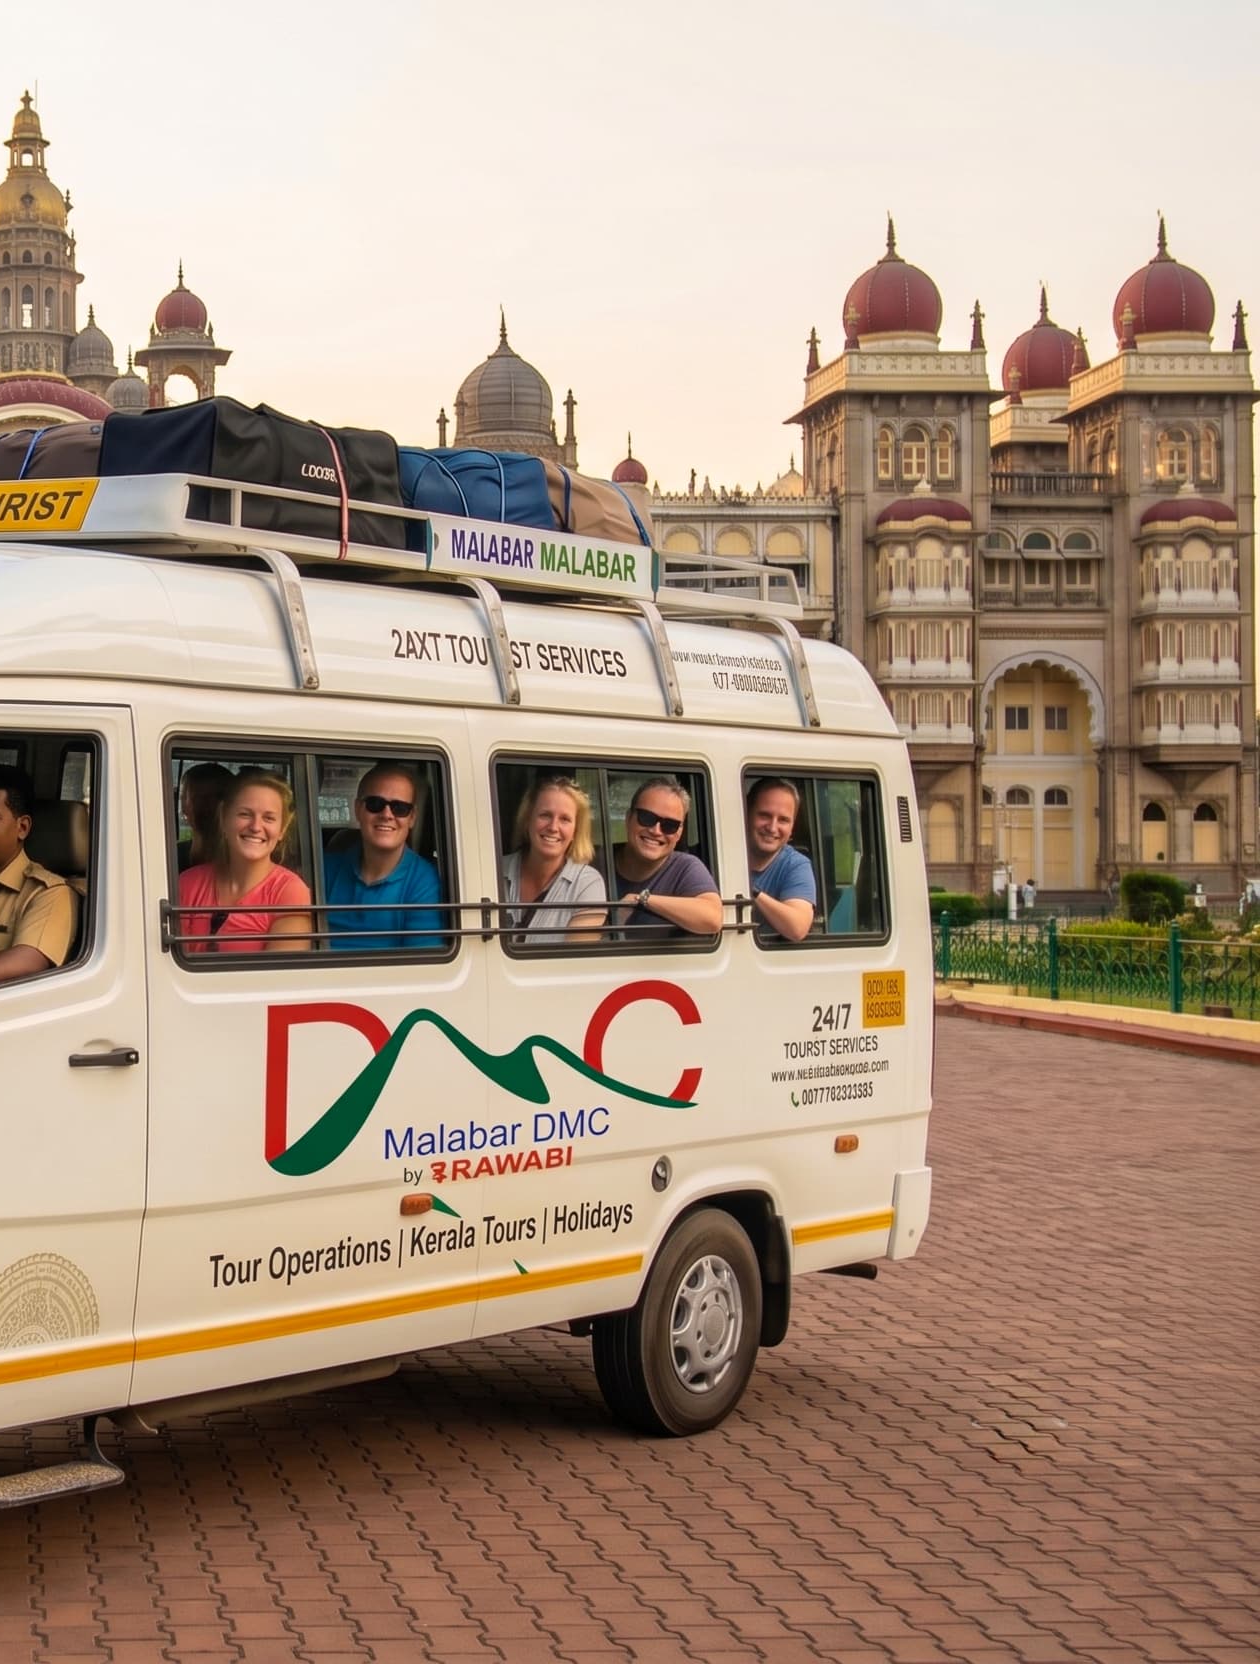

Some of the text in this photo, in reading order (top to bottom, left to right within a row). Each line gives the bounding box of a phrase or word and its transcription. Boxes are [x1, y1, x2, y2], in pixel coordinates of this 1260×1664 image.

[451, 528, 637, 583] MALABAR MALABAR
[538, 643, 627, 678] SERVICES
[812, 1003, 852, 1032] 24/7
[829, 1035, 878, 1055] SERVICES
[384, 1107, 610, 1160] Malabar DMC
[403, 1167, 423, 1186] by
[210, 1200, 633, 1288] Tour Operations Kerala Tours Holidays
